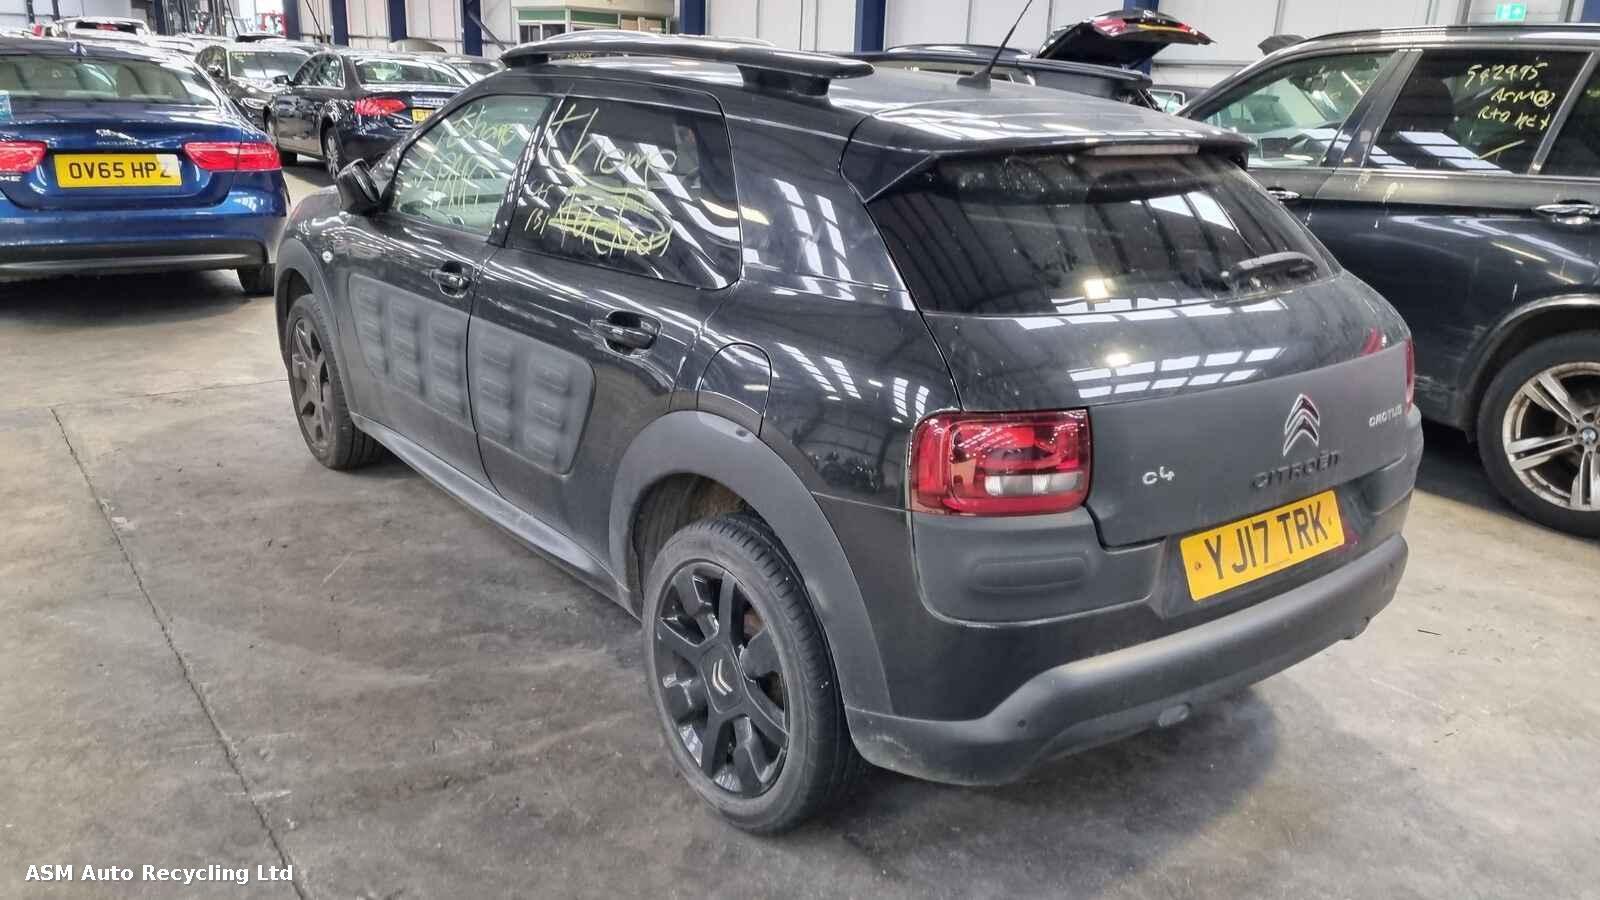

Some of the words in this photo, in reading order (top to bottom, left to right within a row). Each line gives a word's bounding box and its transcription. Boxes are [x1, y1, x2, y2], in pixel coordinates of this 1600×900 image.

[68, 162, 126, 179] OV65
[1142, 465, 1175, 485] C4
[1204, 519, 1269, 580] YJ17
[1277, 501, 1329, 554] TRK
